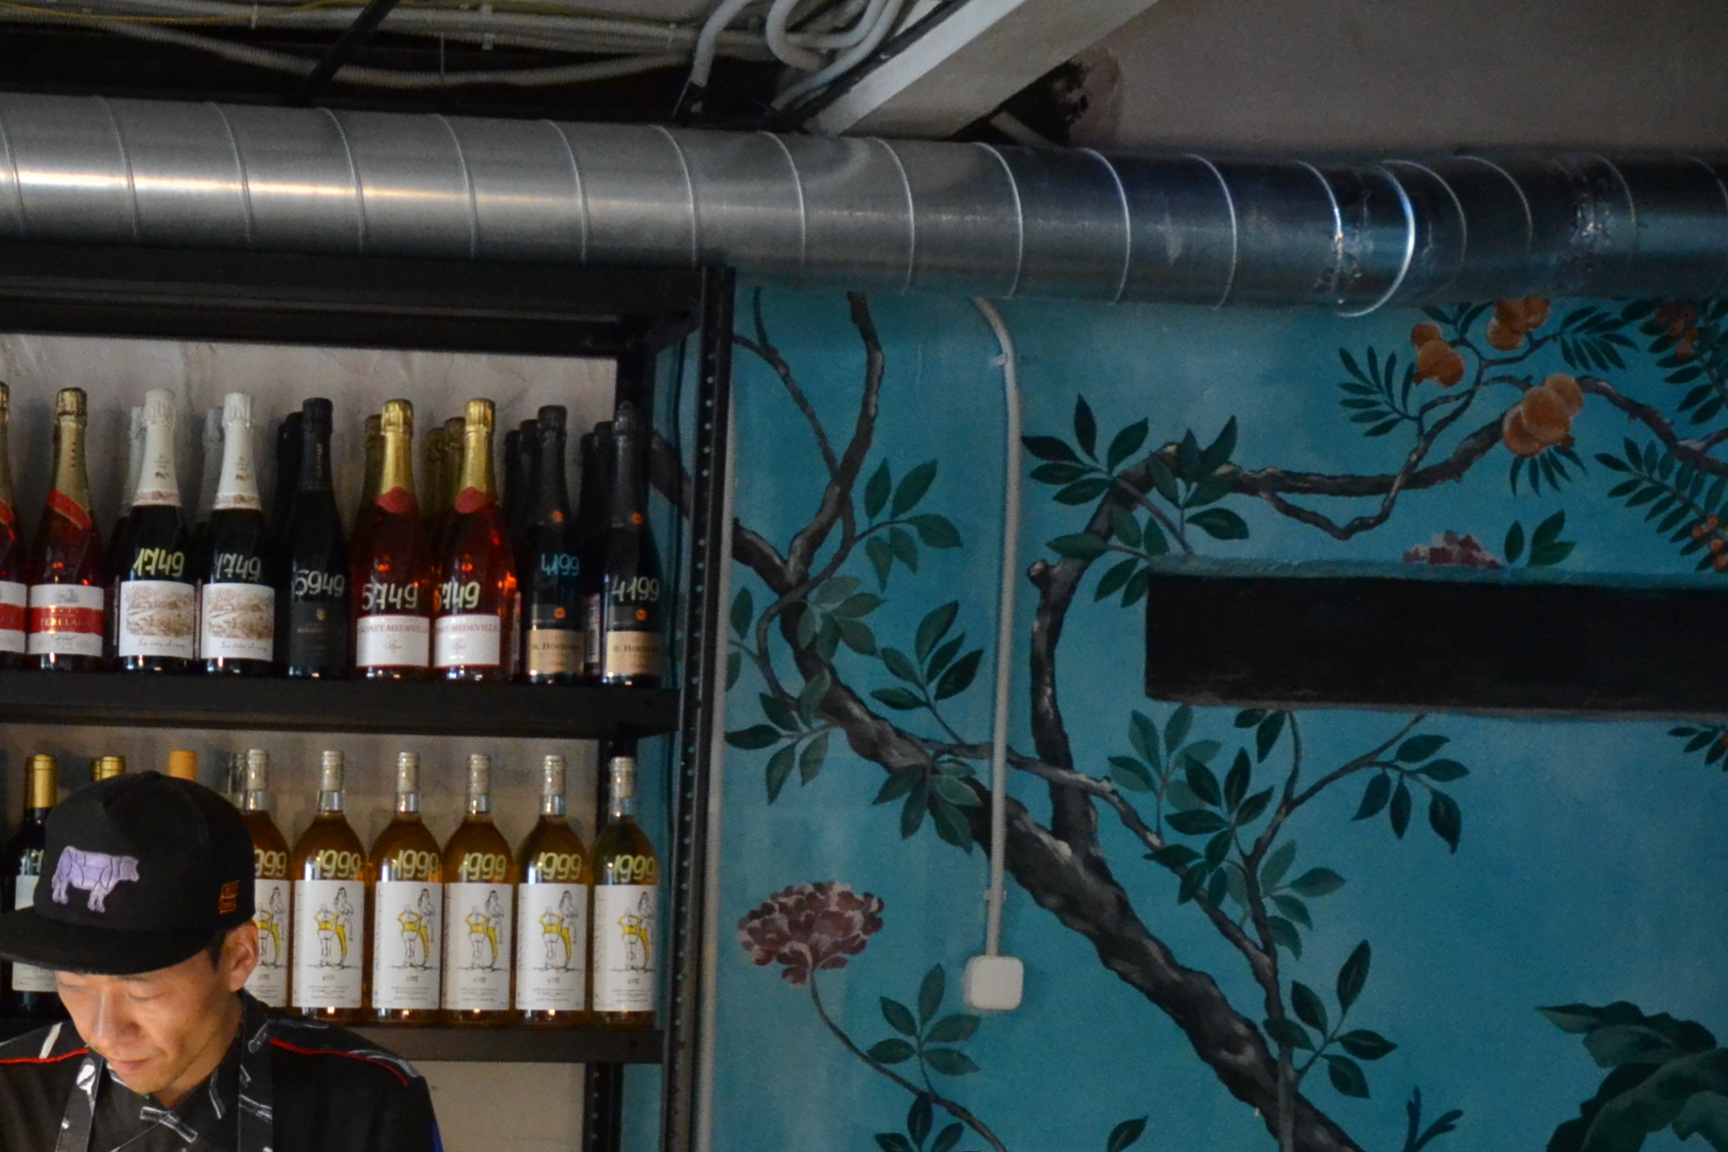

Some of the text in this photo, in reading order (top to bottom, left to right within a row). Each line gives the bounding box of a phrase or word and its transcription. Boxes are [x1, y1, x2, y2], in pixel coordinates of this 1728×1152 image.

[133, 547, 185, 578] 1749
[217, 552, 262, 583] 1749
[540, 553, 580, 577] 4199
[293, 569, 346, 598] 5949
[361, 581, 419, 611] 5749
[611, 575, 660, 603] 4199
[254, 848, 287, 879] 999
[312, 848, 361, 879] 1999
[394, 848, 440, 880] 1999
[457, 852, 507, 883] 1999
[536, 850, 582, 881] 1999
[612, 853, 658, 884] 1999
